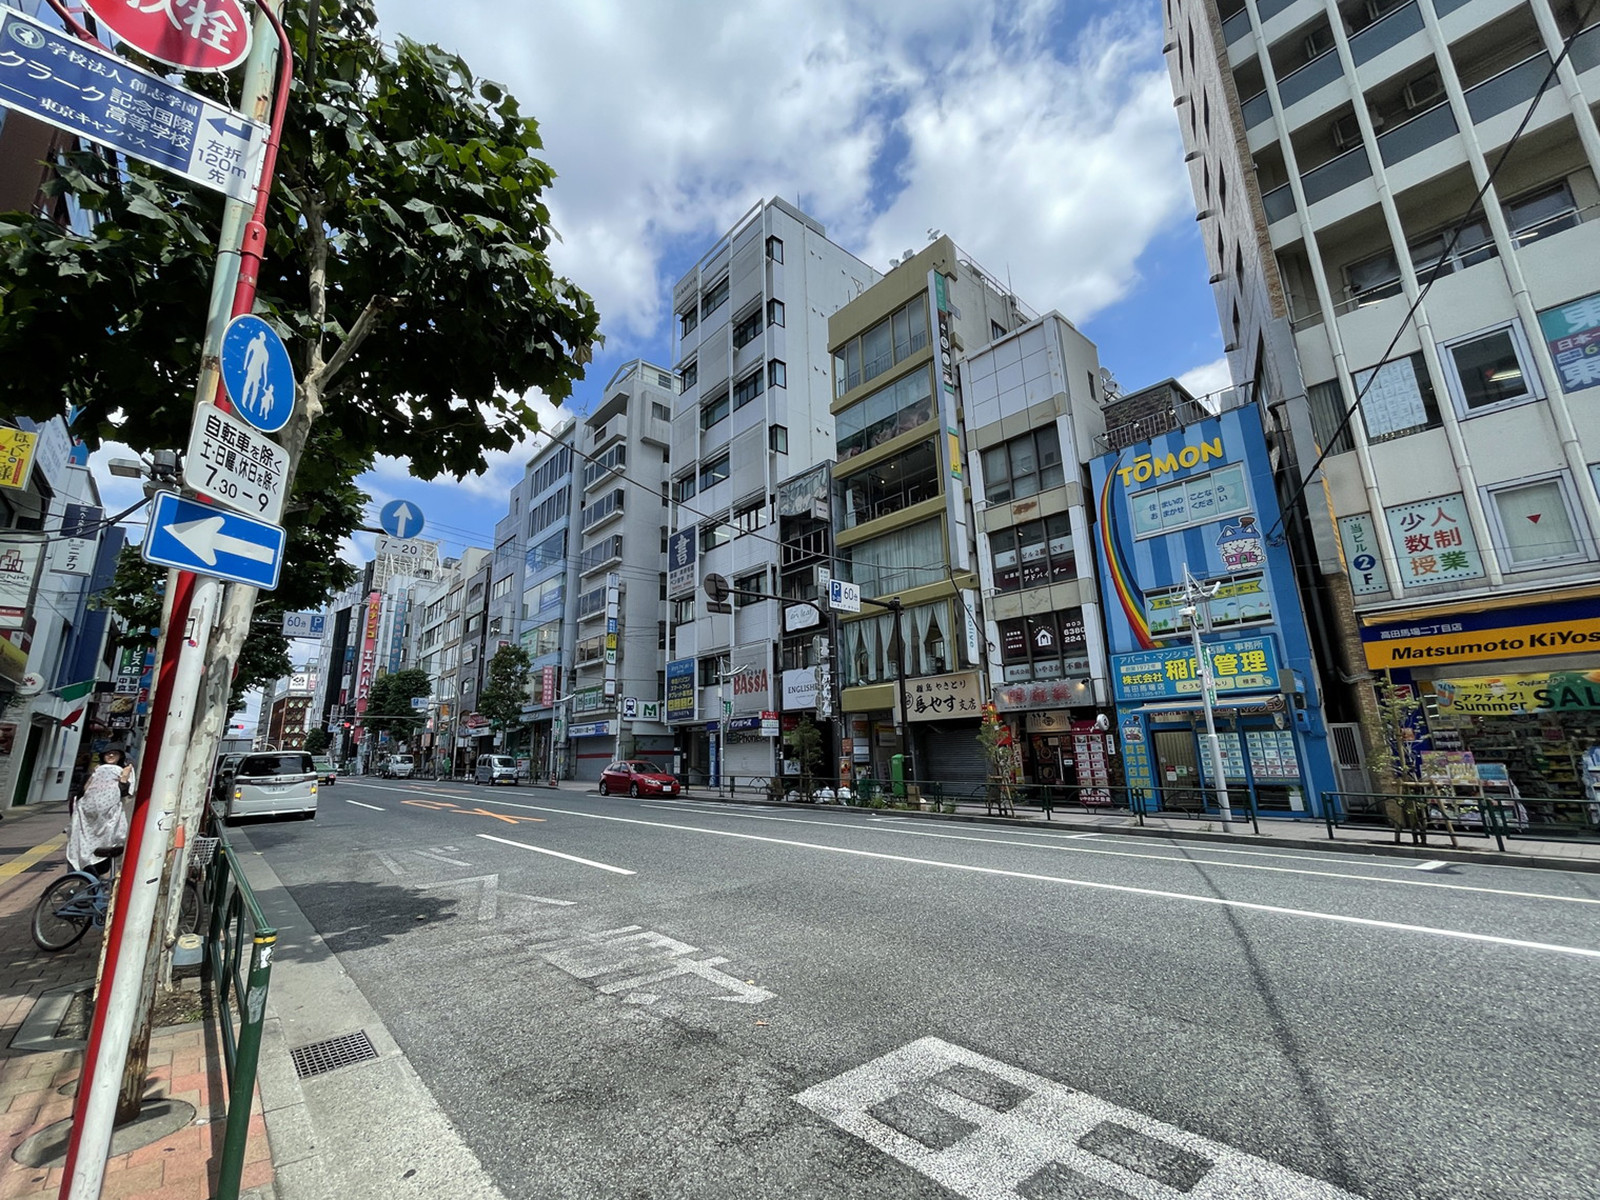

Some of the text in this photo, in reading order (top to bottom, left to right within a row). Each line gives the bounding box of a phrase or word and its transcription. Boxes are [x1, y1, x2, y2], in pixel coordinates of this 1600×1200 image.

[0, 50, 106, 102] クラーク
[48, 41, 198, 117] 学校法人 創志学園
[109, 87, 195, 134] 記念国際
[39, 97, 147, 149] 東京キャンパス
[104, 103, 191, 151] 高等学校
[207, 139, 242, 162] 左折
[197, 149, 247, 179] 120m
[207, 170, 225, 185] 先
[205, 414, 283, 472] 自転車を除く
[1148, 486, 1226, 511] 住まいのことなら
[1150, 494, 1228, 521] おまかせください
[844, 587, 858, 601] 60分
[287, 616, 307, 628] 60分
[366, 603, 378, 638] パチンコ
[1380, 622, 1463, 640] 高田馬場二丁目店
[1391, 638, 1524, 660] Matsumoto
[123, 666, 140, 674] 2F
[359, 650, 373, 699] エスパス
[1122, 672, 1164, 685] 株式会社
[935, 679, 966, 691] やきとり
[959, 698, 977, 711] 支店
[1454, 700, 1528, 712] Summer
